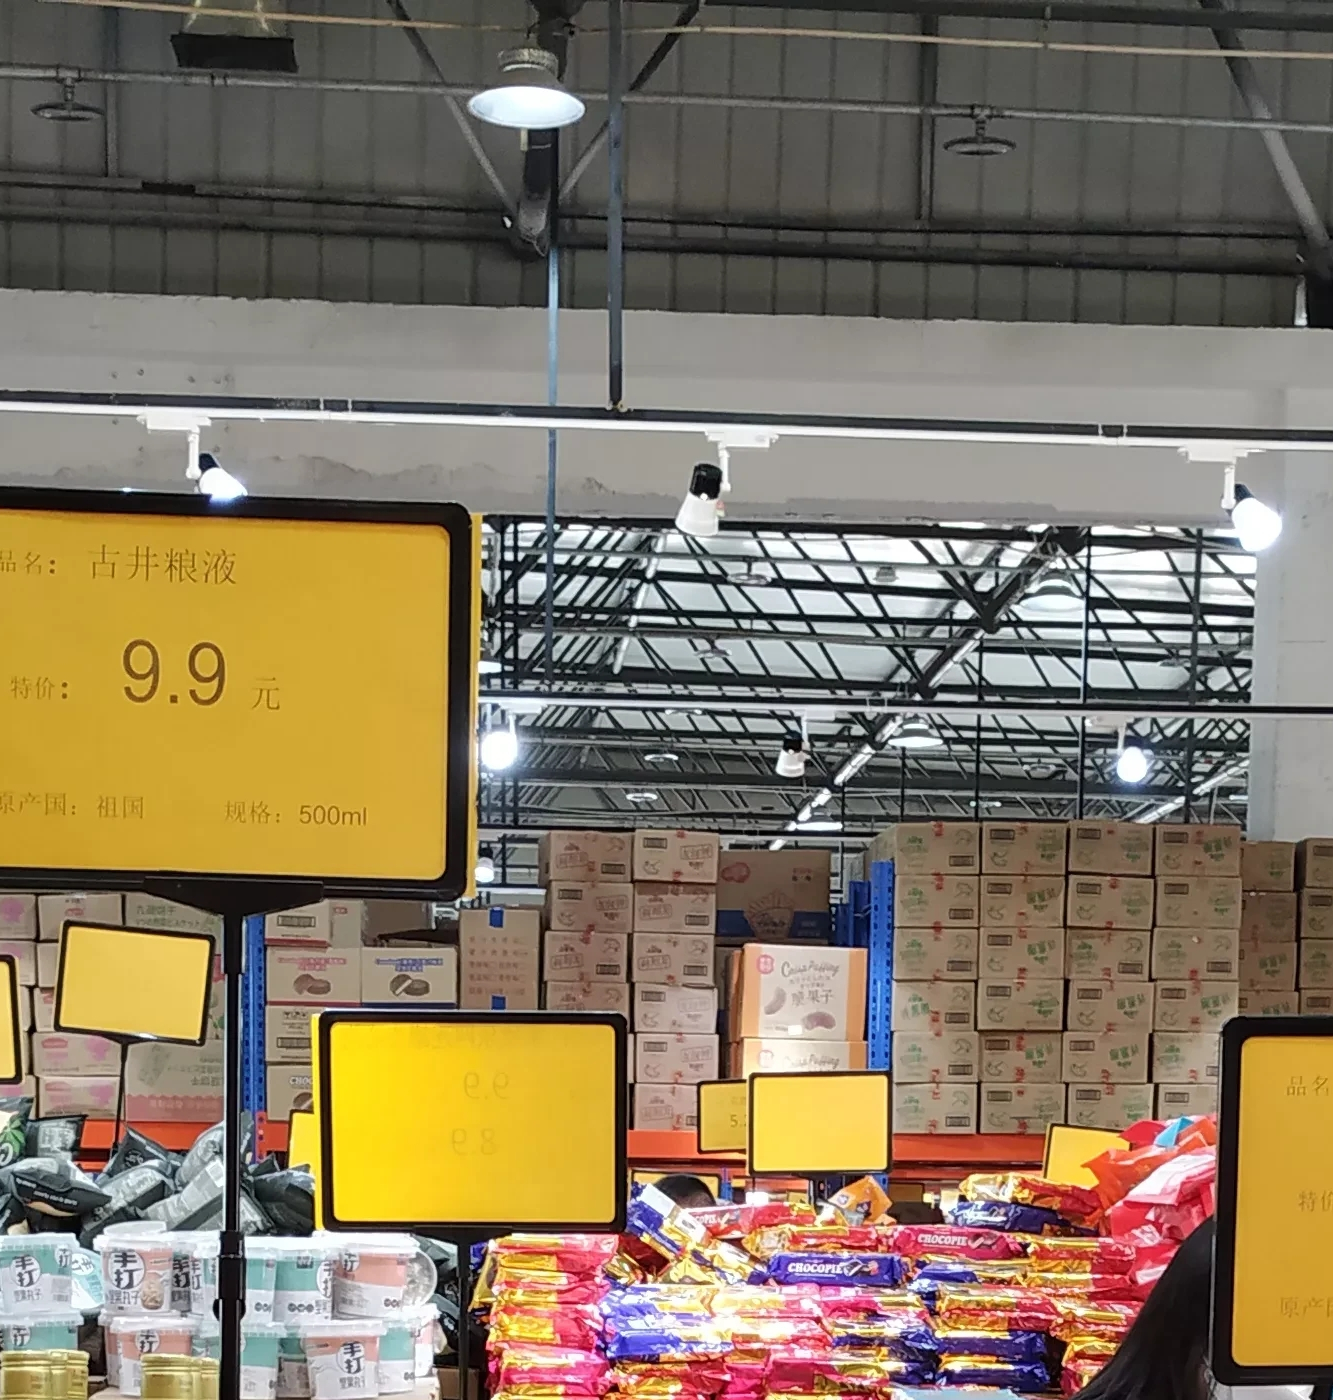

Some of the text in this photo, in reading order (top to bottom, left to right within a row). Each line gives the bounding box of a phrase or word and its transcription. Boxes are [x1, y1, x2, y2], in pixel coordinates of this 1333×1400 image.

[88, 544, 237, 585] 古井粮液
[10, 639, 281, 711] 特价: 9.9 元
[97, 795, 146, 821] 祖国
[224, 800, 281, 827] 规格:
[298, 803, 368, 827] 500ml
[916, 1233, 969, 1248] CHOCOPIE
[14, 1253, 39, 1288] 手打
[112, 1248, 137, 1289] 手打
[787, 1261, 844, 1276] CHOCOPIE
[339, 1342, 362, 1375] 手打
